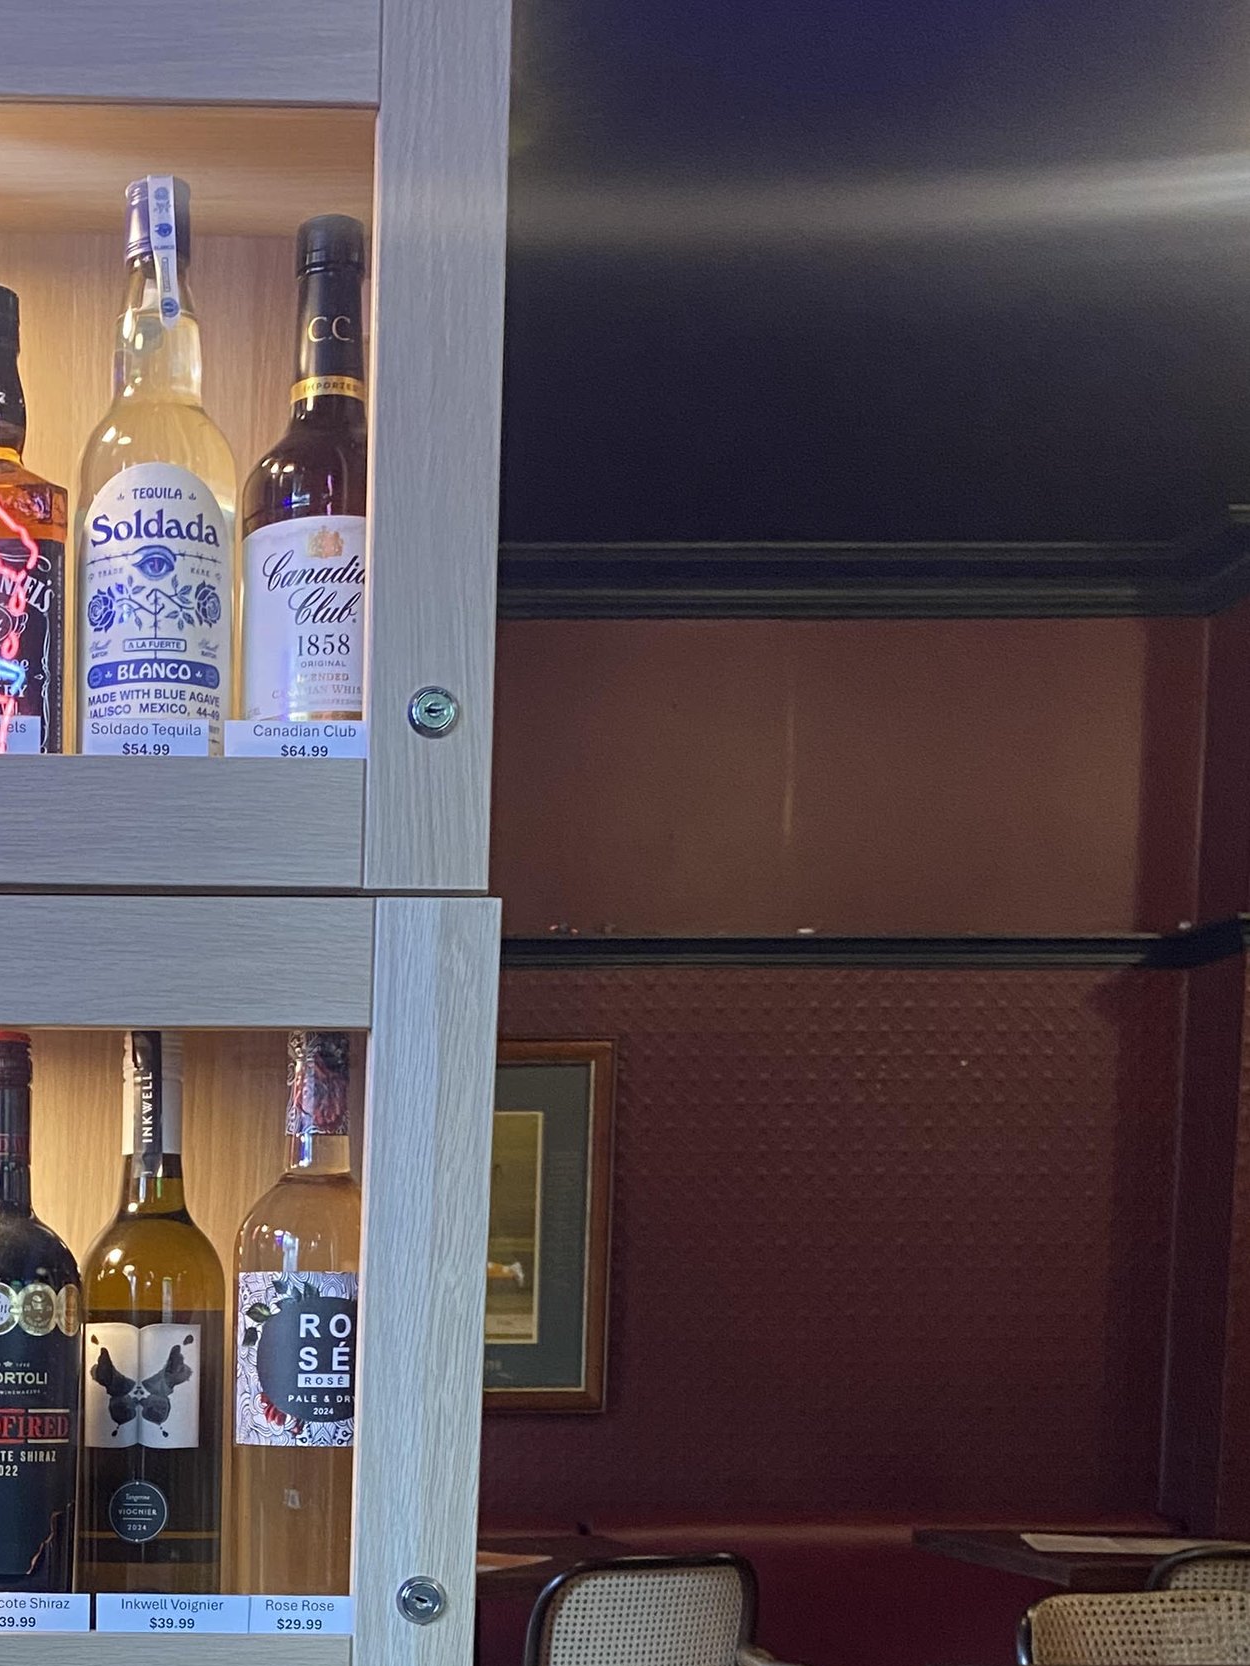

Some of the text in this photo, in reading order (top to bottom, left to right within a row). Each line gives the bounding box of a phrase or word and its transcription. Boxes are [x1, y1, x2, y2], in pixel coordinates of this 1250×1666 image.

[132, 487, 183, 500] TEQUILA
[90, 508, 220, 548] Soldada
[297, 633, 351, 657] 1858
[117, 662, 192, 681] BLANCO
[88, 689, 220, 708] MADE WITH BLUE AGAVE
[91, 722, 202, 738] Soldado Tequila
[253, 724, 357, 738] Canadian Club
[122, 742, 170, 757] $54.99
[280, 744, 329, 758] $64.99
[141, 1071, 153, 1144] INKWELL
[299, 1313, 352, 1339] RO
[298, 1341, 350, 1372] SÉ
[287, 1394, 330, 1403] PALE &
[312, 1407, 334, 1416] 2024
[19, 1449, 57, 1462] SHIRAZ
[29, 1597, 71, 1610] Shiraz
[265, 1599, 335, 1612] Rose Rose
[149, 1617, 196, 1630] $39.99
[276, 1618, 323, 1630] $29.99
